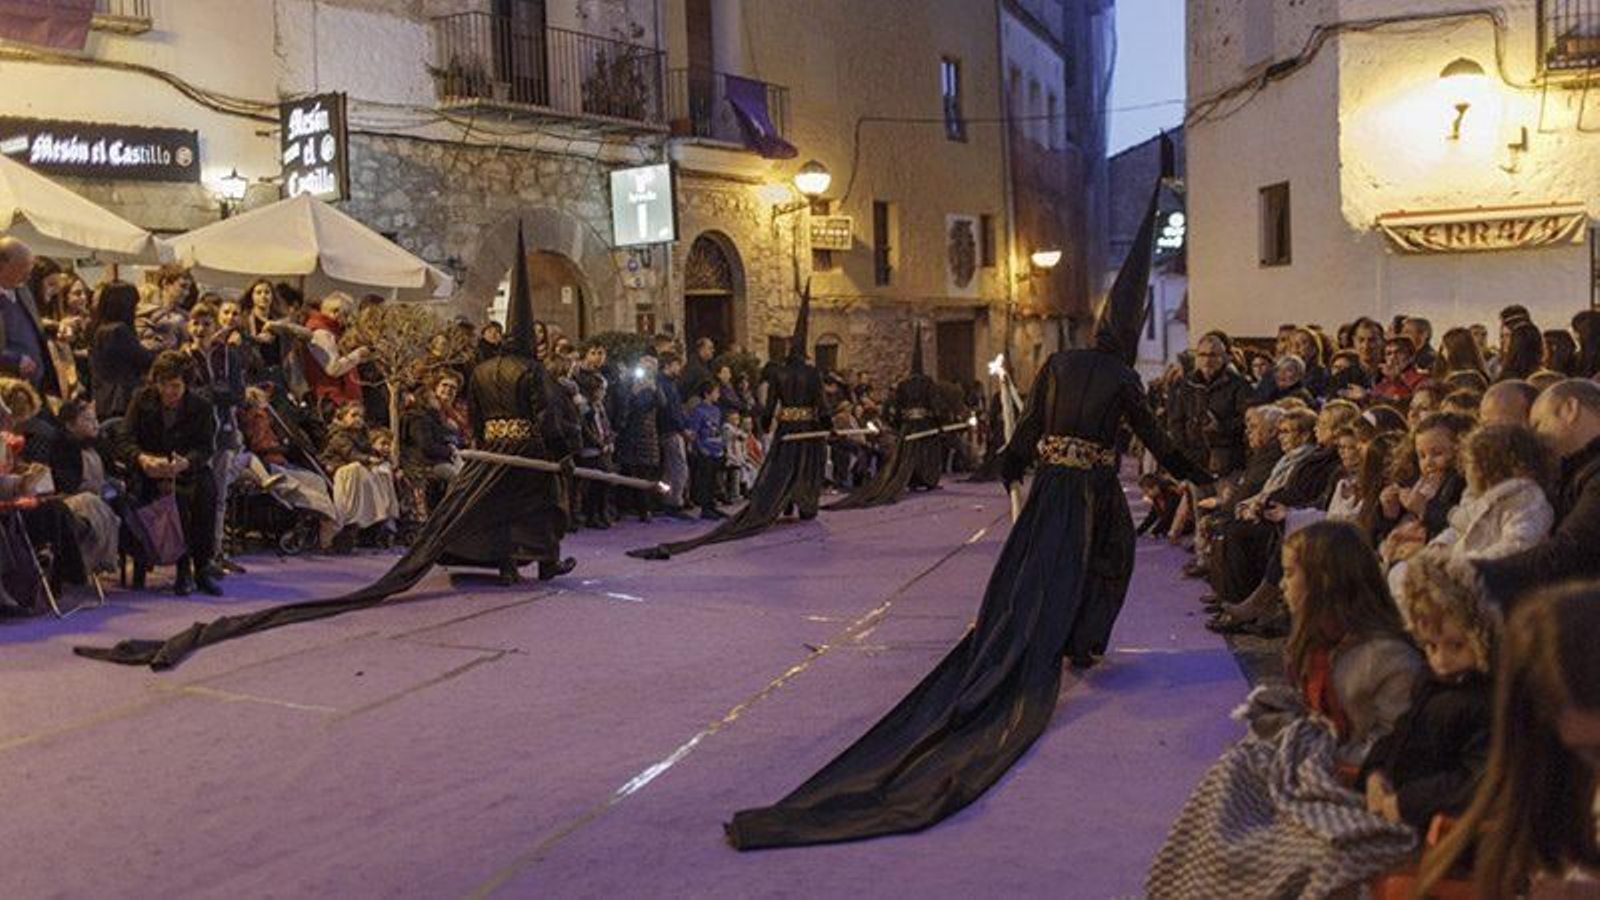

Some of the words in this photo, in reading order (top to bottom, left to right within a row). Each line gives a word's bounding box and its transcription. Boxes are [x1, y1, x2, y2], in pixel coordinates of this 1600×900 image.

[287, 102, 330, 140] Mesón
[30, 133, 89, 164] Mesón
[91, 138, 106, 164] el
[109, 139, 171, 166] Castillo
[303, 137, 317, 167] el
